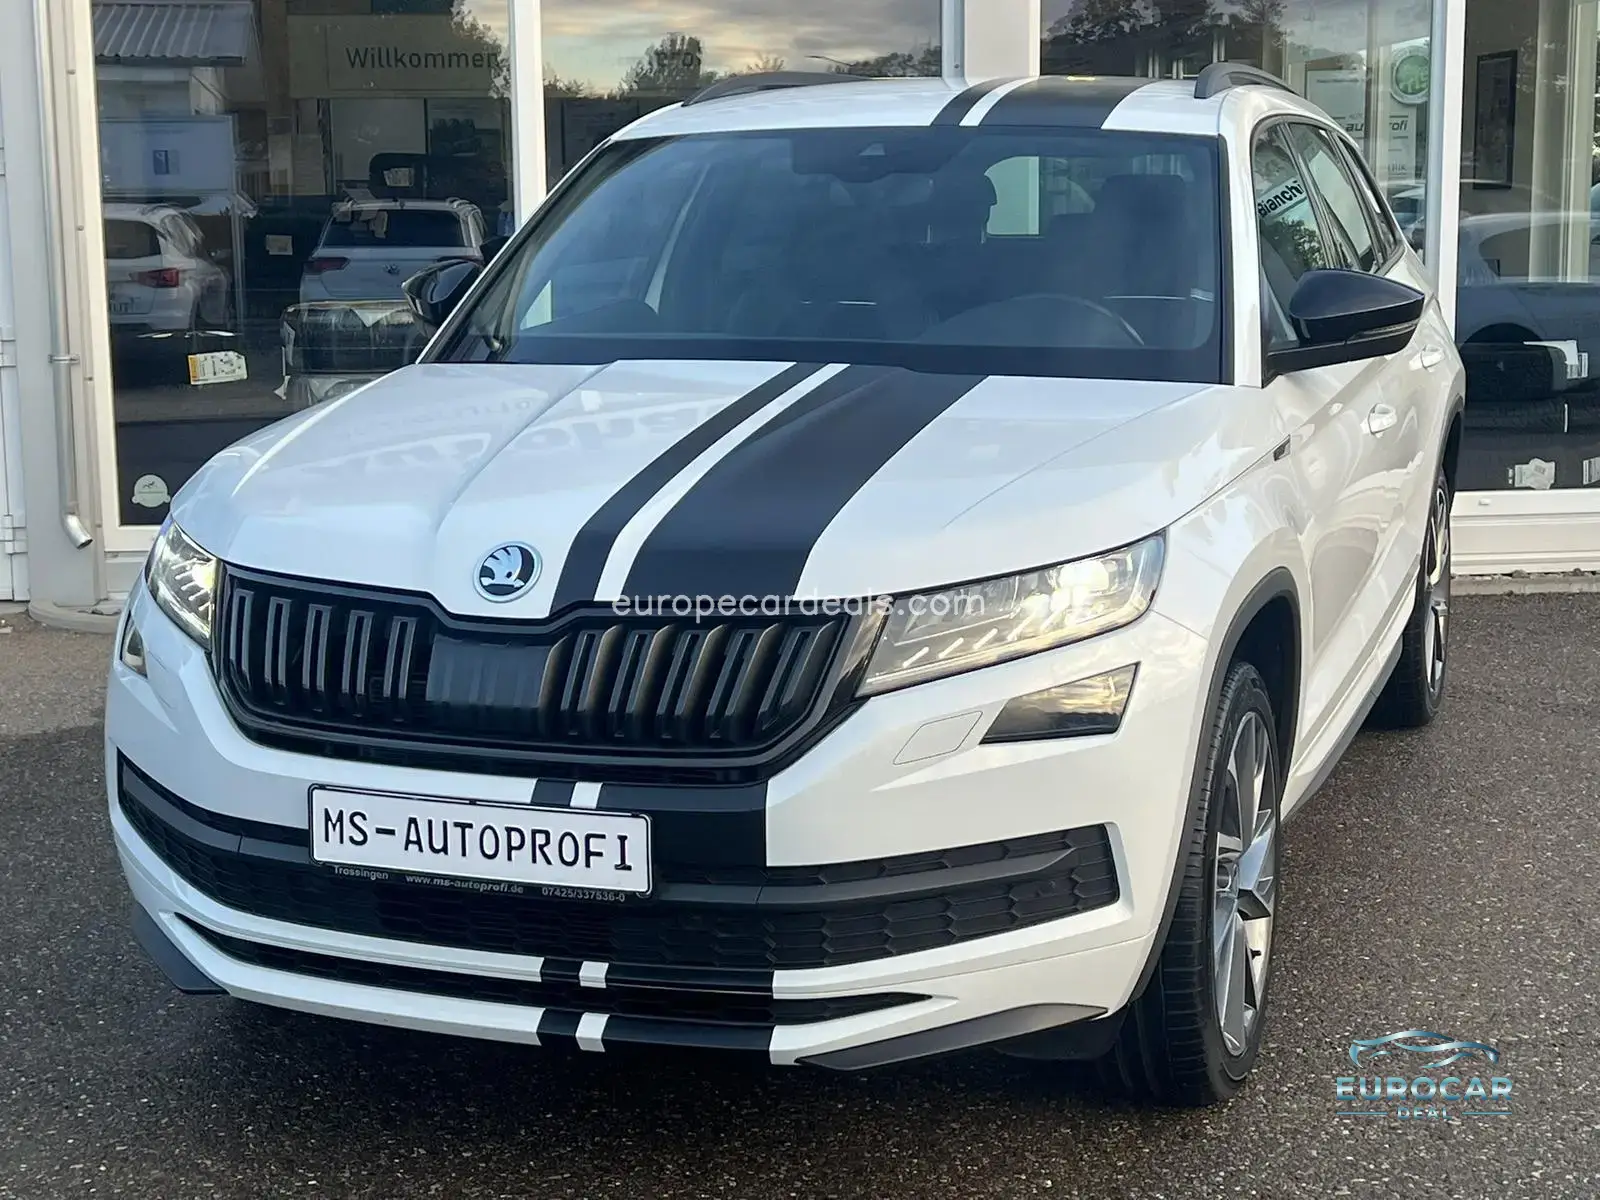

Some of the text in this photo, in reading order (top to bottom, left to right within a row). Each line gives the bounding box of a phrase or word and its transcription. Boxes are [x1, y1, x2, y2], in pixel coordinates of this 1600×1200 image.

[345, 47, 500, 69] Willkommen
[323, 807, 633, 872] MS-AUTOPROFI
[333, 865, 389, 880] Trossingen
[405, 874, 524, 894] www.ms-autoprofi.de
